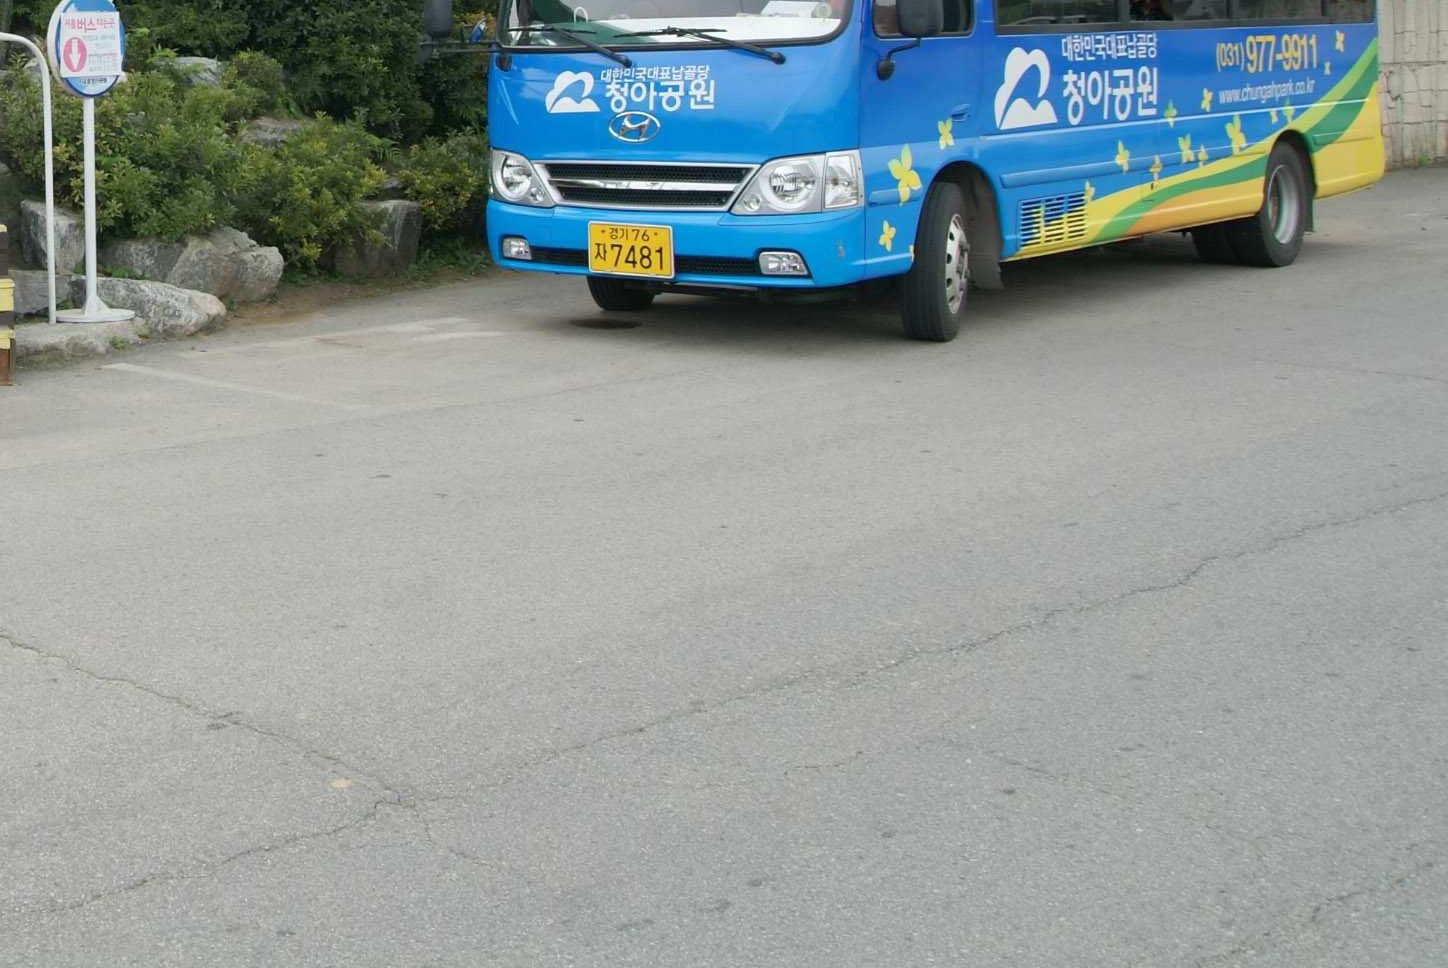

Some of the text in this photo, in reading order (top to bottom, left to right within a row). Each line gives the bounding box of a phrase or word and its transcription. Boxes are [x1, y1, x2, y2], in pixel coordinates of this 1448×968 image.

[1061, 33, 1158, 61] 대한민국대표납골당
[1246, 33, 1317, 73] 977-9911
[600, 65, 710, 82] 대한민국대표납골당
[605, 79, 715, 113] 청아공원
[1063, 65, 1158, 126] 청아공원
[1218, 77, 1315, 104] www.chungahpark.co.kr
[609, 227, 650, 242] 경기 76
